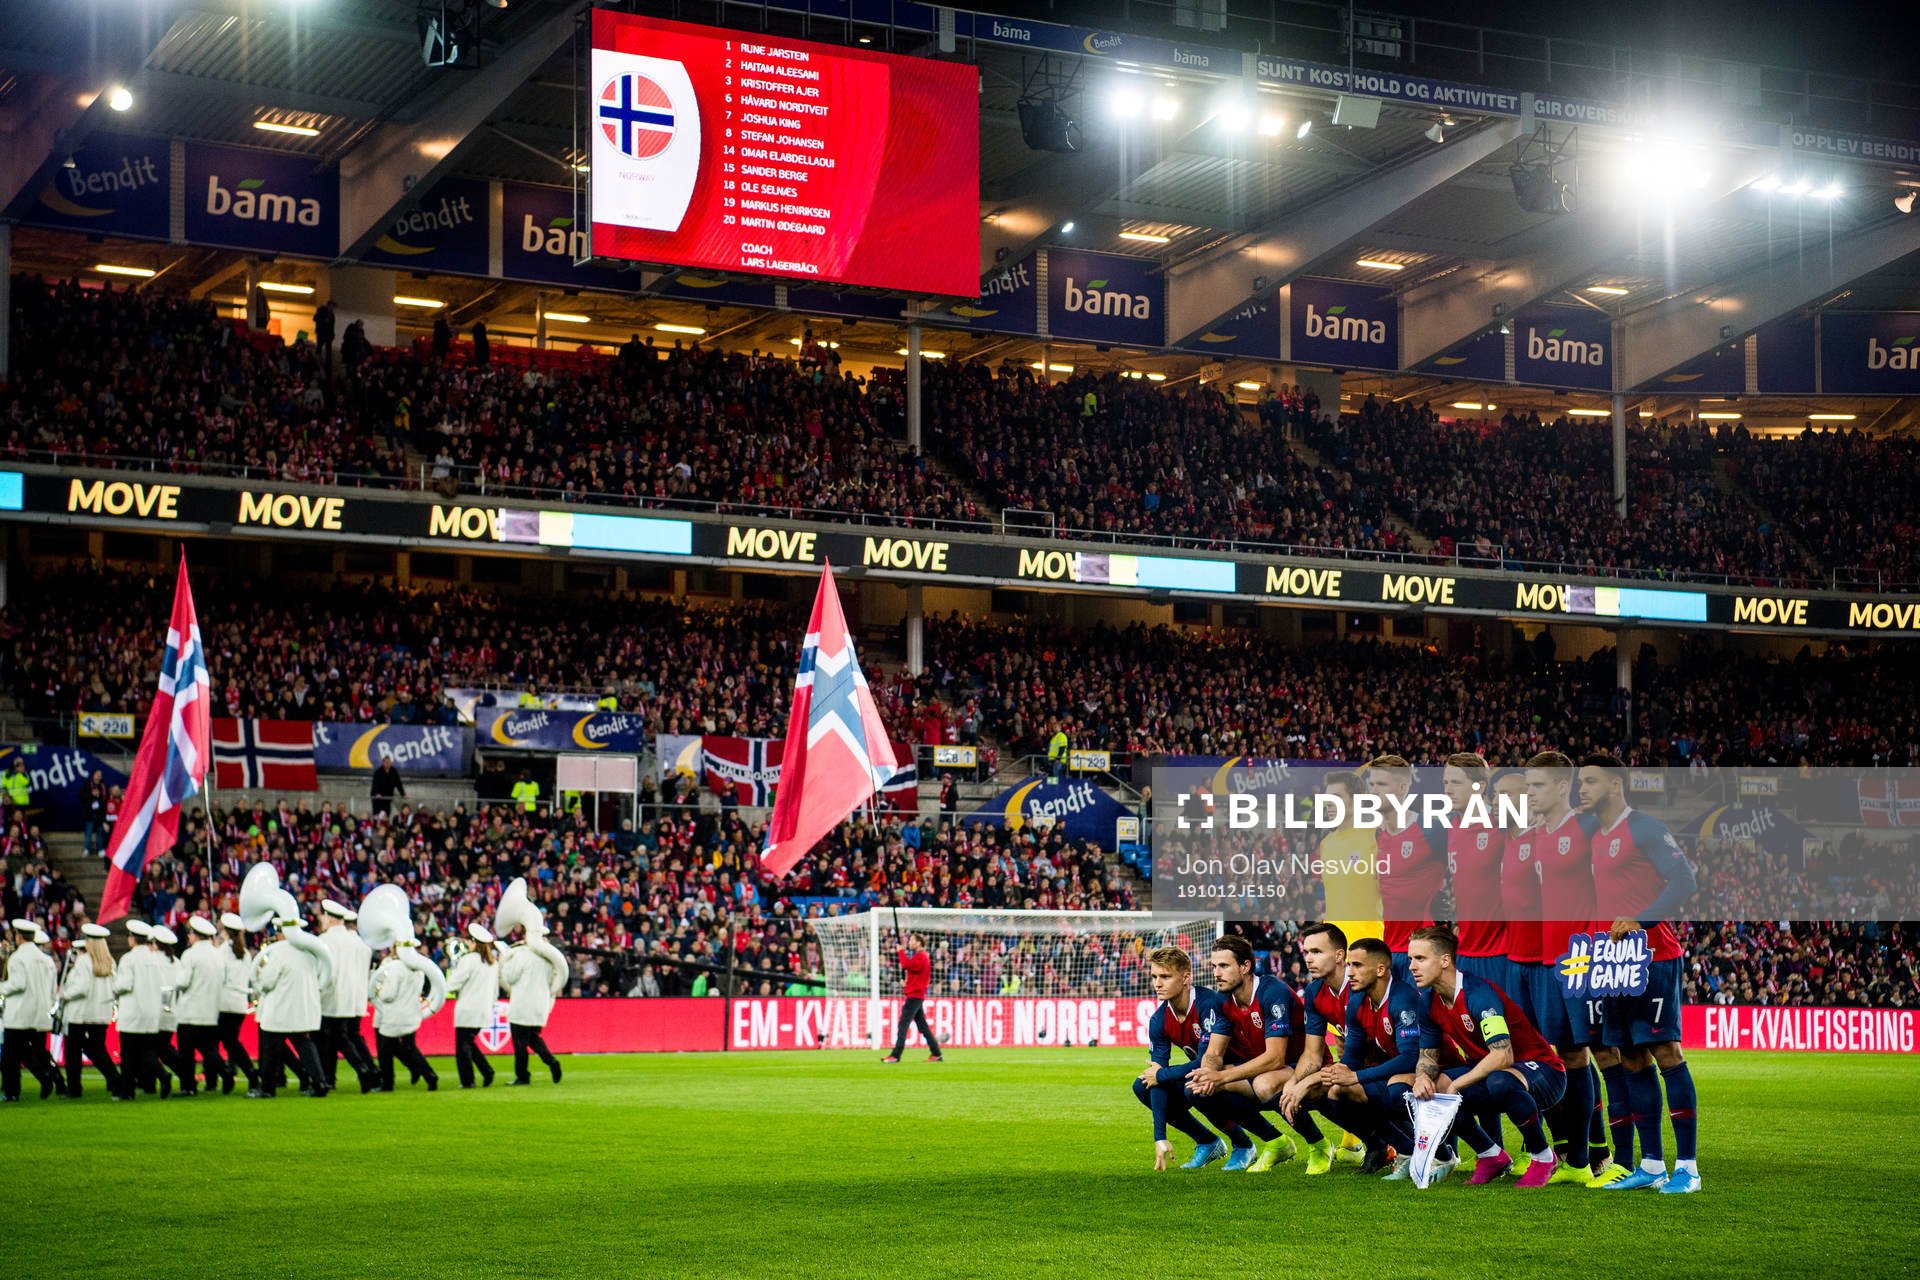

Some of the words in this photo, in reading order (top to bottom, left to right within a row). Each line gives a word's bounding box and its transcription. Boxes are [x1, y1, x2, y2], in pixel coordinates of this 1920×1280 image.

[993, 21, 1031, 41] bama
[1093, 35, 1123, 50] Bendit
[725, 41, 731, 50] 1
[740, 43, 765, 55] RUNE
[767, 46, 809, 61] JARSTEIN
[1173, 48, 1209, 68] bama
[725, 59, 731, 68] 2
[740, 61, 774, 74] HAITAM
[776, 66, 819, 80] ALEESAMI
[725, 76, 732, 85] 3
[740, 78, 794, 94] KRISTOFFER
[796, 85, 819, 98] AJER
[1257, 60, 1305, 81] SUNT
[1309, 69, 1400, 95] KOSTHOLD
[1405, 84, 1430, 100] OG
[1433, 86, 1518, 110] AKTIVITET
[725, 93, 732, 102] 6
[740, 94, 777, 109] HÅVARD
[779, 101, 829, 116] NORDTVEIT
[1534, 99, 1562, 116] GIR
[725, 110, 732, 119] 7
[740, 113, 777, 127] JOSHUA
[779, 118, 801, 129] KING
[725, 128, 732, 137] 8
[740, 130, 774, 143] STEFAN
[776, 134, 824, 149] JOHANSEN
[1793, 133, 1858, 153] OPPLEV
[723, 146, 735, 155] 14
[741, 148, 768, 159] OMAR
[769, 151, 835, 168] ELABDELLAOUI
[68, 156, 159, 197] Bendit
[723, 163, 735, 172] 15
[741, 164, 777, 178] SANDER
[778, 169, 808, 182] BERGE
[723, 180, 735, 190] 18
[741, 181, 759, 193] OLE
[207, 175, 320, 226] bama
[723, 197, 735, 207] 19
[741, 199, 779, 213] MARKUS
[780, 204, 830, 219] HENRIKSEN
[723, 215, 736, 225] 20
[741, 216, 775, 229] MARTIN
[777, 221, 826, 235] ØDEGAARD
[741, 243, 773, 255] COACH
[741, 257, 765, 268] LARS
[1064, 278, 1150, 320] bama
[1305, 304, 1387, 344] bama
[1528, 327, 1603, 367] bama
[67, 478, 181, 519] MOVE
[237, 491, 345, 531] MOVE
[727, 526, 818, 562] MOVE
[863, 537, 949, 572] MOVE
[1266, 566, 1342, 598] MOVE
[1381, 574, 1456, 605] MOVE
[1734, 597, 1809, 625] MOVE
[507, 711, 549, 737] Bendit
[587, 715, 630, 740] Bendit
[377, 726, 454, 764] Bendit
[1233, 758, 1291, 794] Bendit
[1029, 782, 1096, 817] Bendit
[1720, 807, 1776, 839] Bendit
[1590, 964, 1642, 990] GAME
[1652, 998, 1664, 1023] 7
[1705, 1007, 1914, 1051] EM-KVALIFISERING
